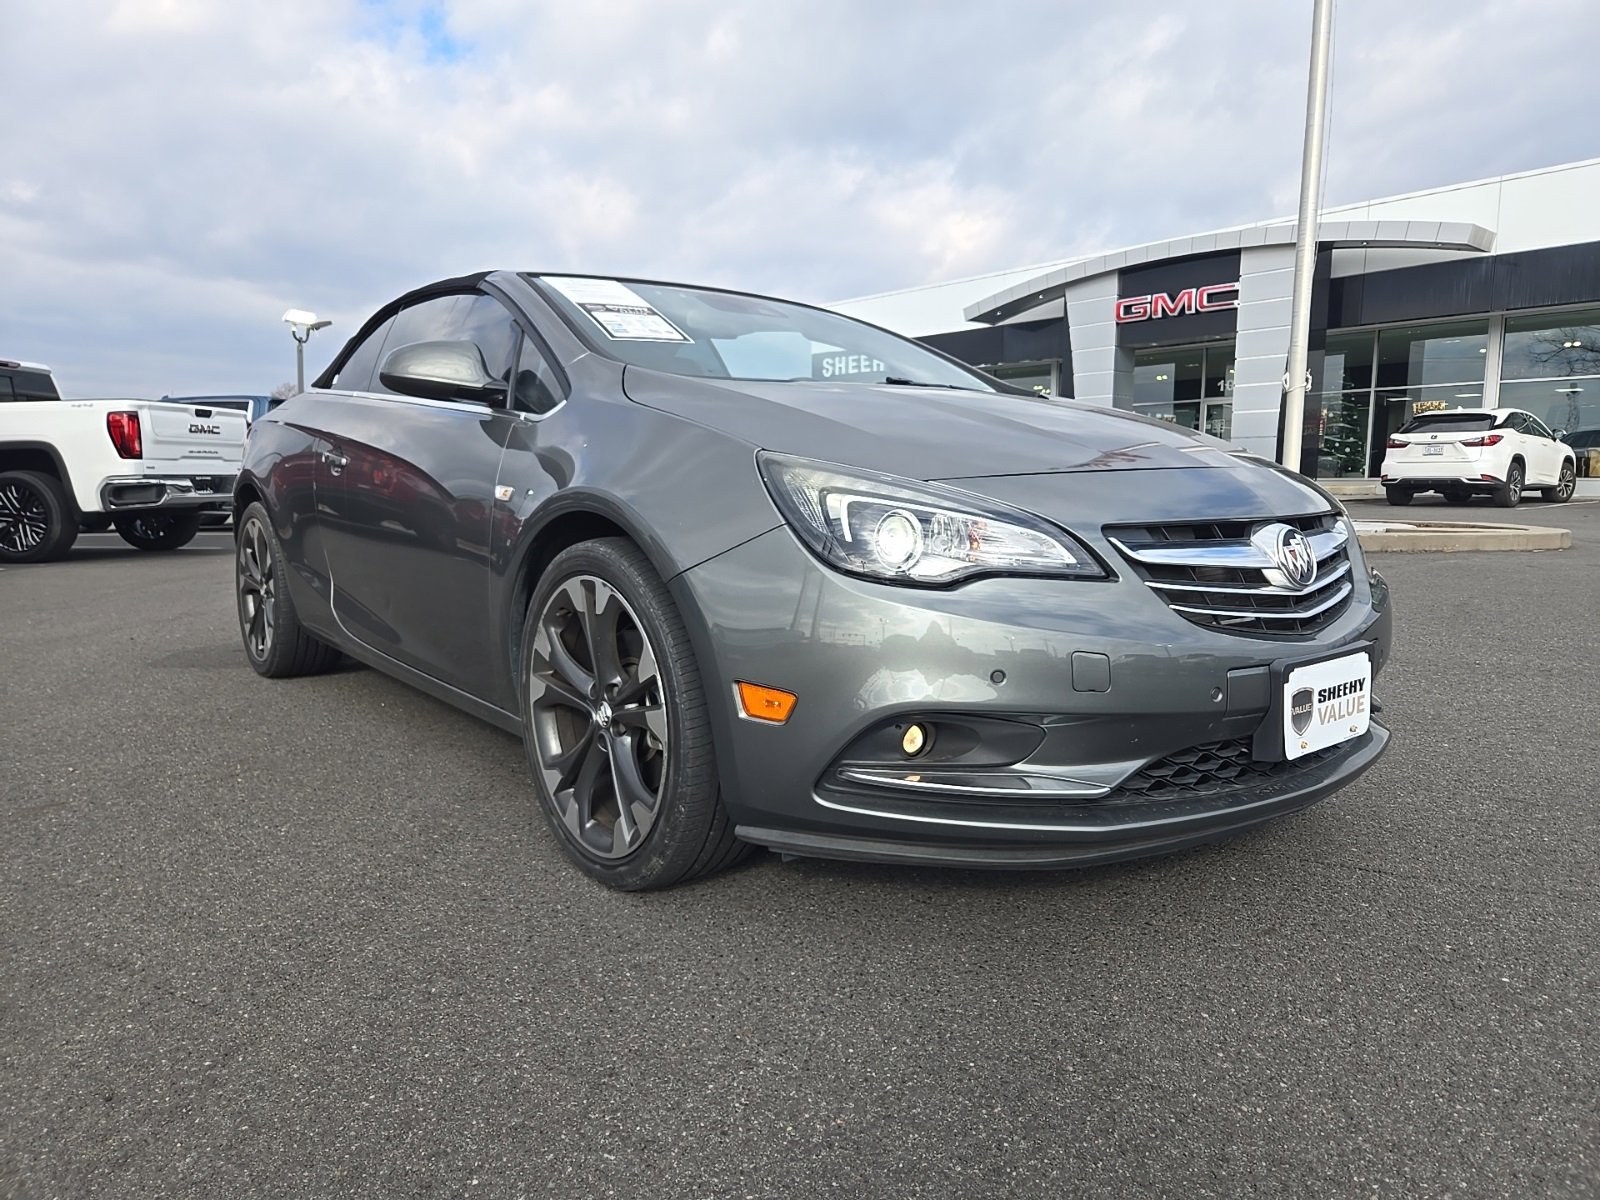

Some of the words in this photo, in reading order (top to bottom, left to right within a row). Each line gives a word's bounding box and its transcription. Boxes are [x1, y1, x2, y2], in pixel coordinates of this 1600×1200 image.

[1115, 281, 1239, 323] GMC
[188, 424, 220, 434] GMC
[1317, 677, 1366, 704] SHEEHY
[1291, 702, 1312, 715] VALUE
[1317, 694, 1366, 726] VALUE
